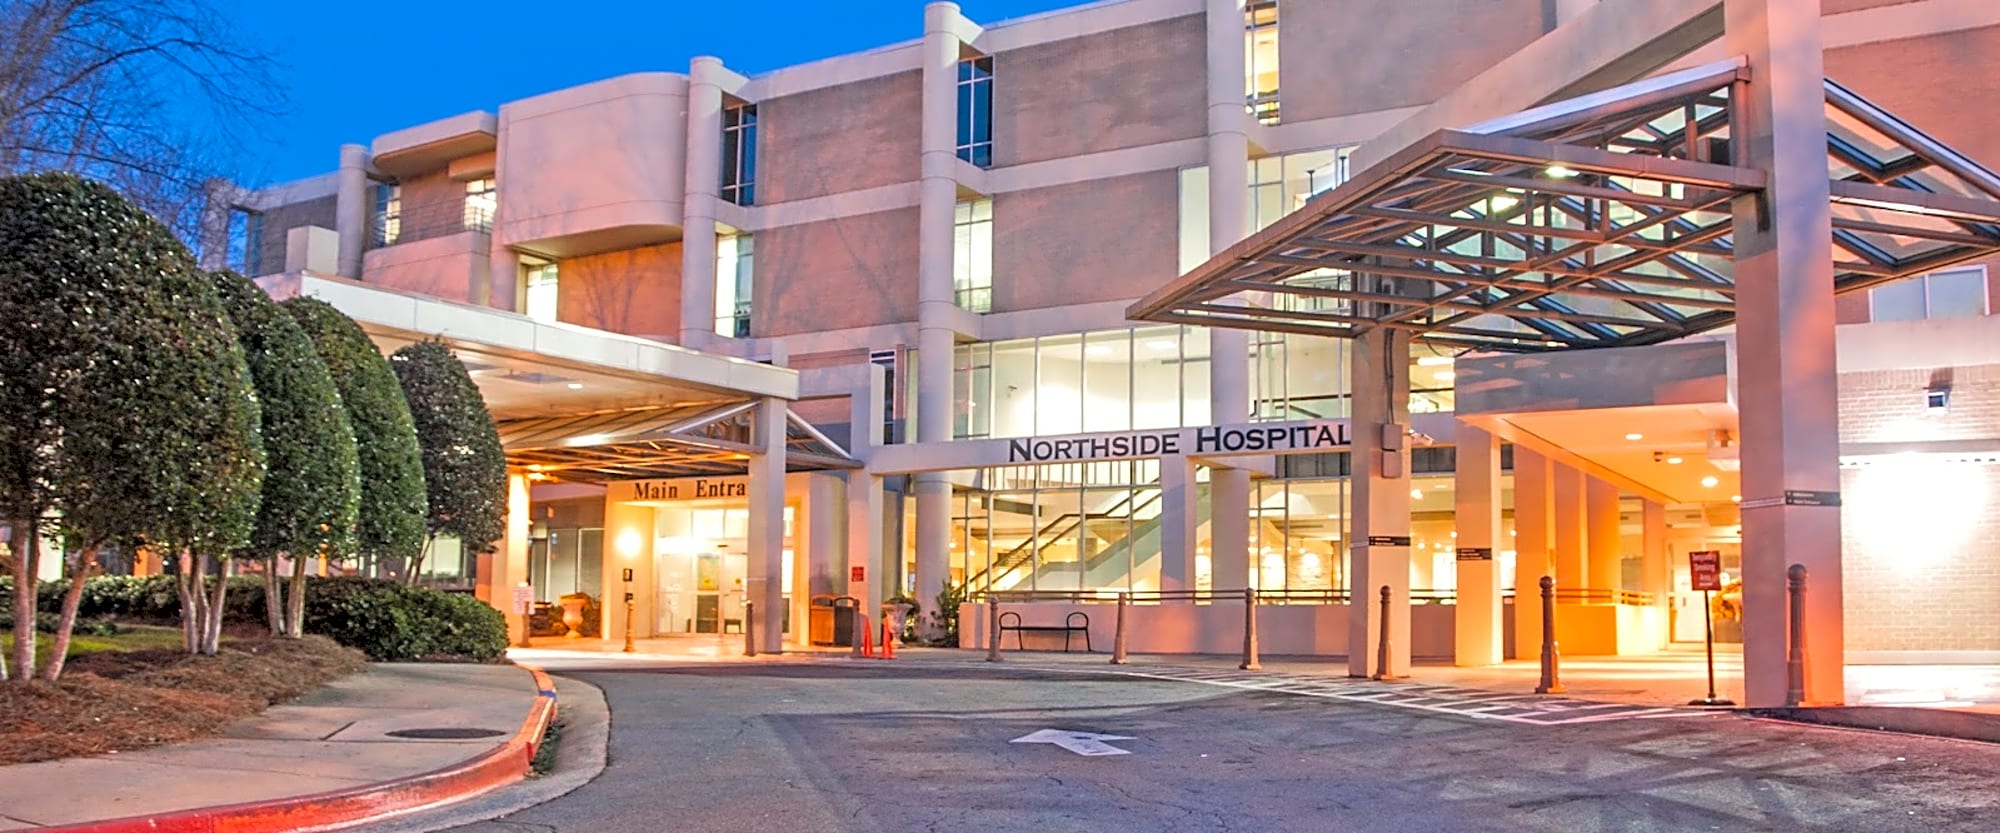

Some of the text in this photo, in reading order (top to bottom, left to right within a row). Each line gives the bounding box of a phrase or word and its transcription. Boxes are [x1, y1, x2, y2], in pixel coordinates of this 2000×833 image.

[1009, 424, 1351, 462] NORTHSIDE HOSPITAL
[634, 482, 678, 500] Main
